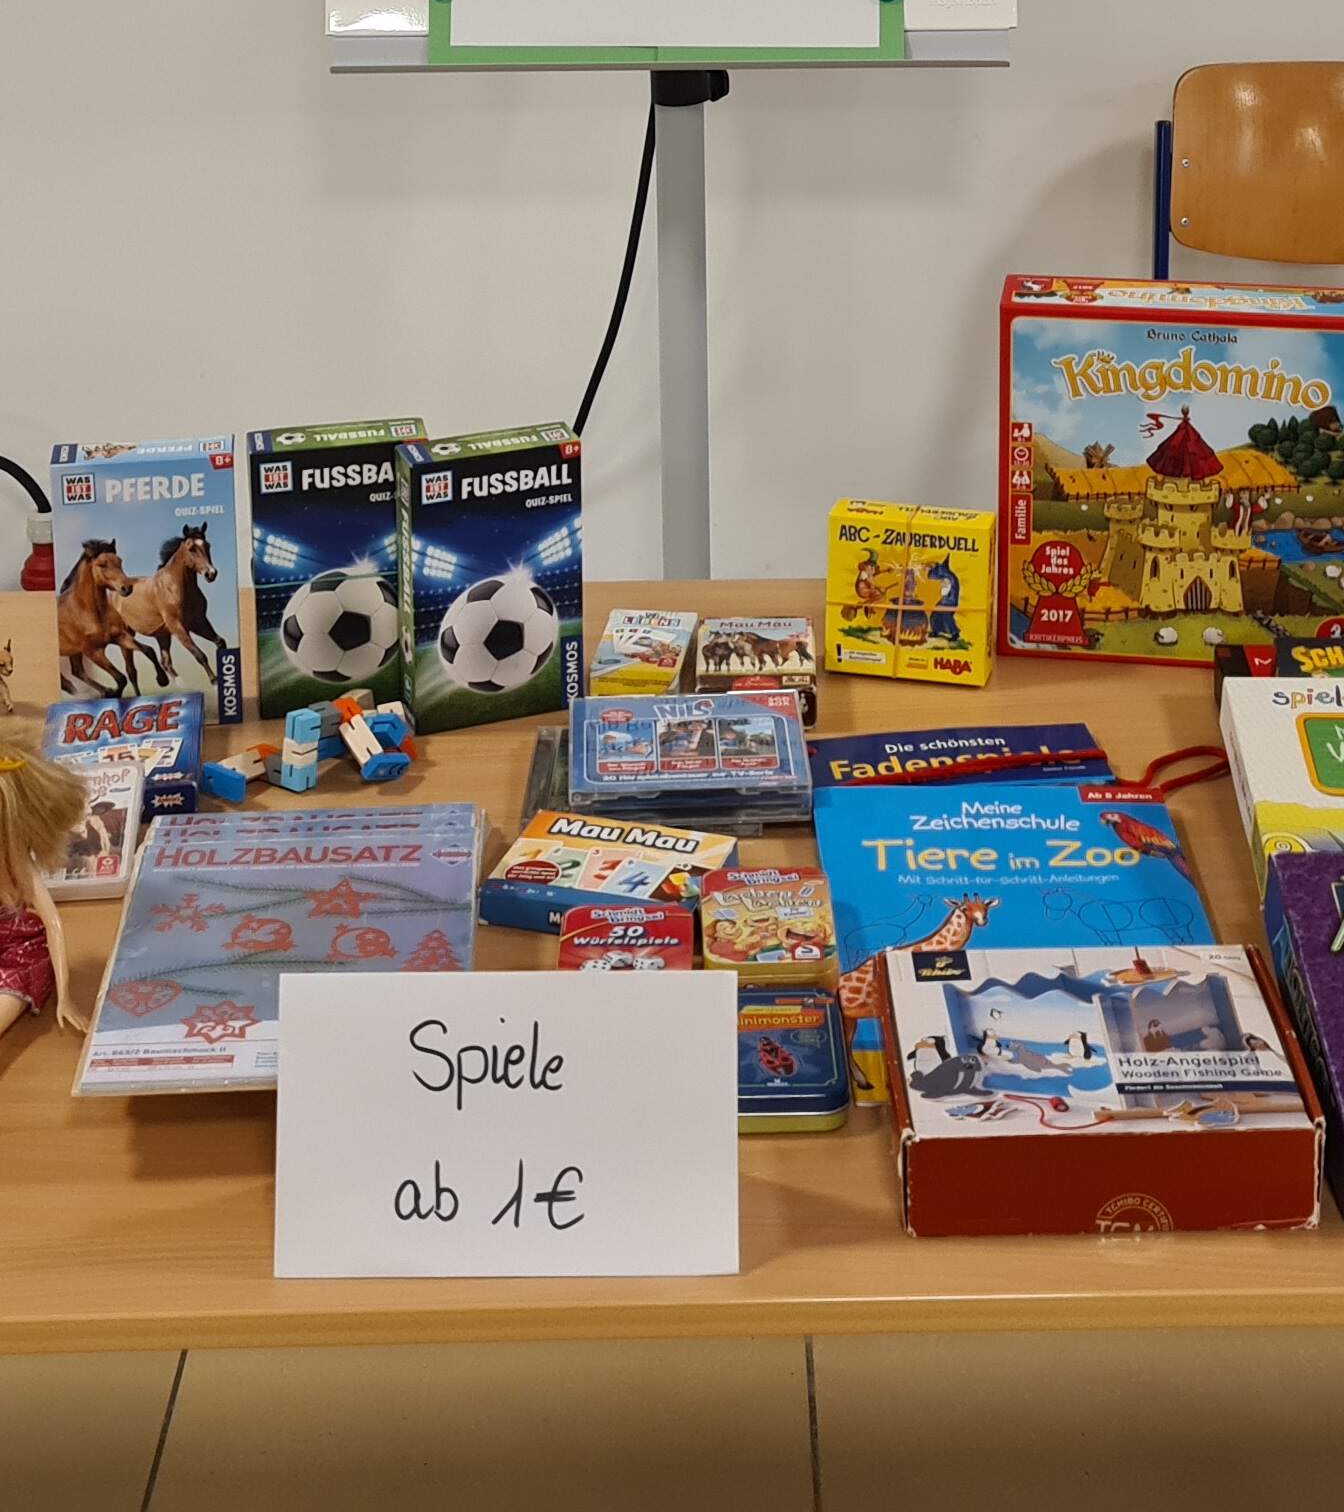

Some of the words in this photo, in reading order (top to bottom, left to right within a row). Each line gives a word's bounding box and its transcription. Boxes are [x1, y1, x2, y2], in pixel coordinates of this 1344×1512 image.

[1147, 328, 1186, 342] Bruno
[1191, 330, 1239, 344] Cathala
[1052, 346, 1331, 409] Kingdomino
[263, 463, 289, 474] WAS
[301, 462, 395, 490] FUSSBA
[65, 475, 91, 486] WAS
[264, 481, 290, 491] WAS
[424, 474, 449, 484] WAS
[460, 463, 573, 500] FUSSBALL
[104, 473, 206, 503] PFERDE
[66, 493, 93, 503] WAS
[425, 491, 450, 502] WAS
[525, 493, 573, 509] QUIZ-SPIEL
[174, 505, 224, 518] QUIZ-SPIEL
[1015, 499, 1027, 540] Familie
[839, 525, 870, 542] ABC
[881, 528, 979, 552] ZAUBERDUELL
[1045, 546, 1070, 558] Spiel
[1051, 557, 1068, 566] des
[1041, 565, 1074, 575] Jahres
[1041, 610, 1073, 622] 2017
[566, 640, 578, 706] KOSMOS
[934, 657, 973, 675] HABA
[222, 654, 237, 717] KOSMOS
[63, 699, 183, 744] RAGE
[884, 743, 914, 755] Die
[919, 736, 1006, 752] schönsten
[961, 801, 1023, 815] Meine
[909, 814, 1081, 833] Zeichenschule
[550, 818, 621, 844] Mau
[624, 827, 700, 855] Mau
[154, 844, 424, 867] HOLZBAUSATZ
[861, 838, 1000, 873] Tiere
[1008, 852, 1041, 869] im
[1045, 839, 1141, 868] Zoo
[897, 873, 922, 885] Mit
[609, 926, 645, 938] 50
[572, 936, 680, 947] Würfelspiele
[409, 1016, 565, 1111] Spiele
[1117, 1054, 1260, 1070] Holz-Angelspiel
[1120, 1068, 1179, 1080] Wooden
[1183, 1066, 1239, 1079] Fishing
[1240, 1068, 1283, 1078] Game
[394, 1159, 460, 1223] ab
